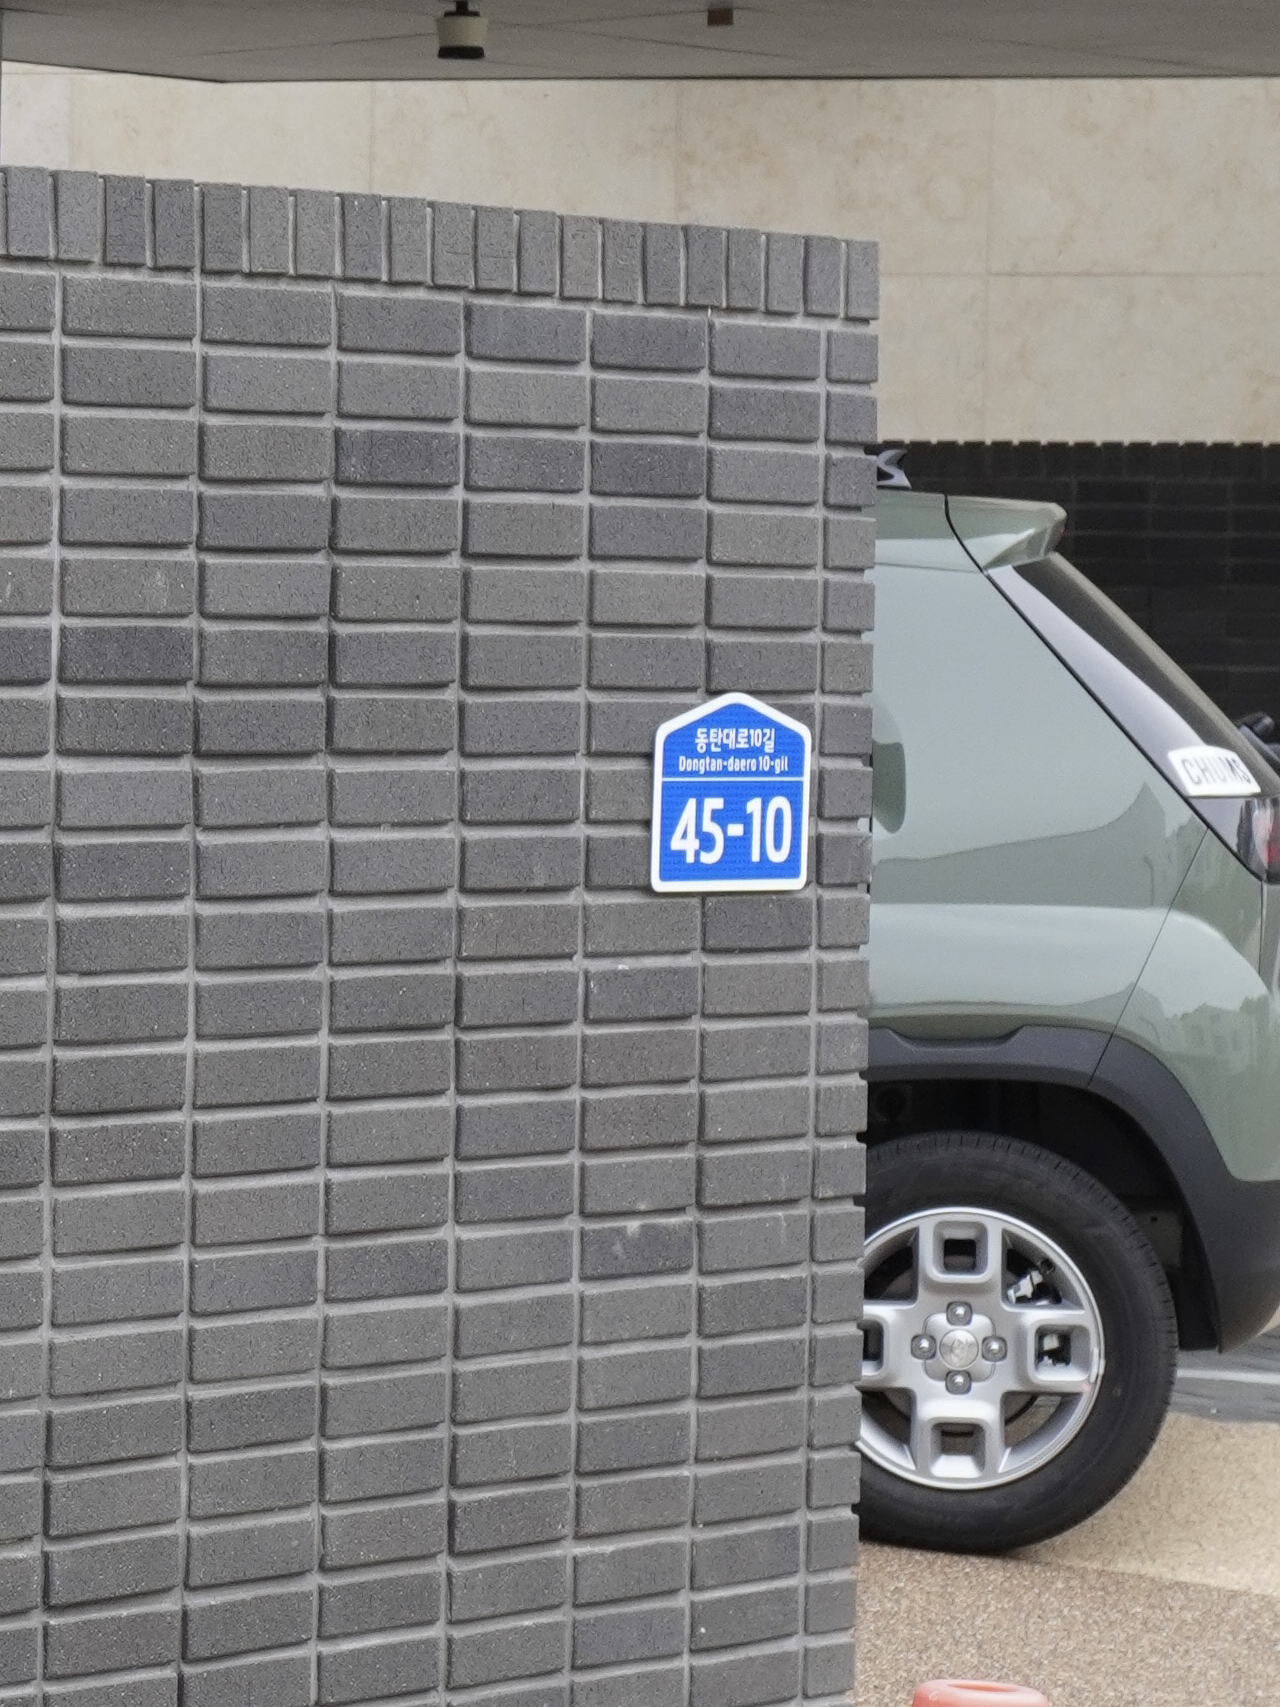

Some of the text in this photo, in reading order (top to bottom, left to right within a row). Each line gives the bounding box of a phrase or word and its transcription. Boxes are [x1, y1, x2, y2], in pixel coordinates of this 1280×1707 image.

[695, 727, 775, 753] 동탄대로10길
[678, 755, 789, 775] Dongtan-daero 10-gil
[1181, 756, 1252, 785] CHUMS
[670, 795, 792, 864] 45-10
